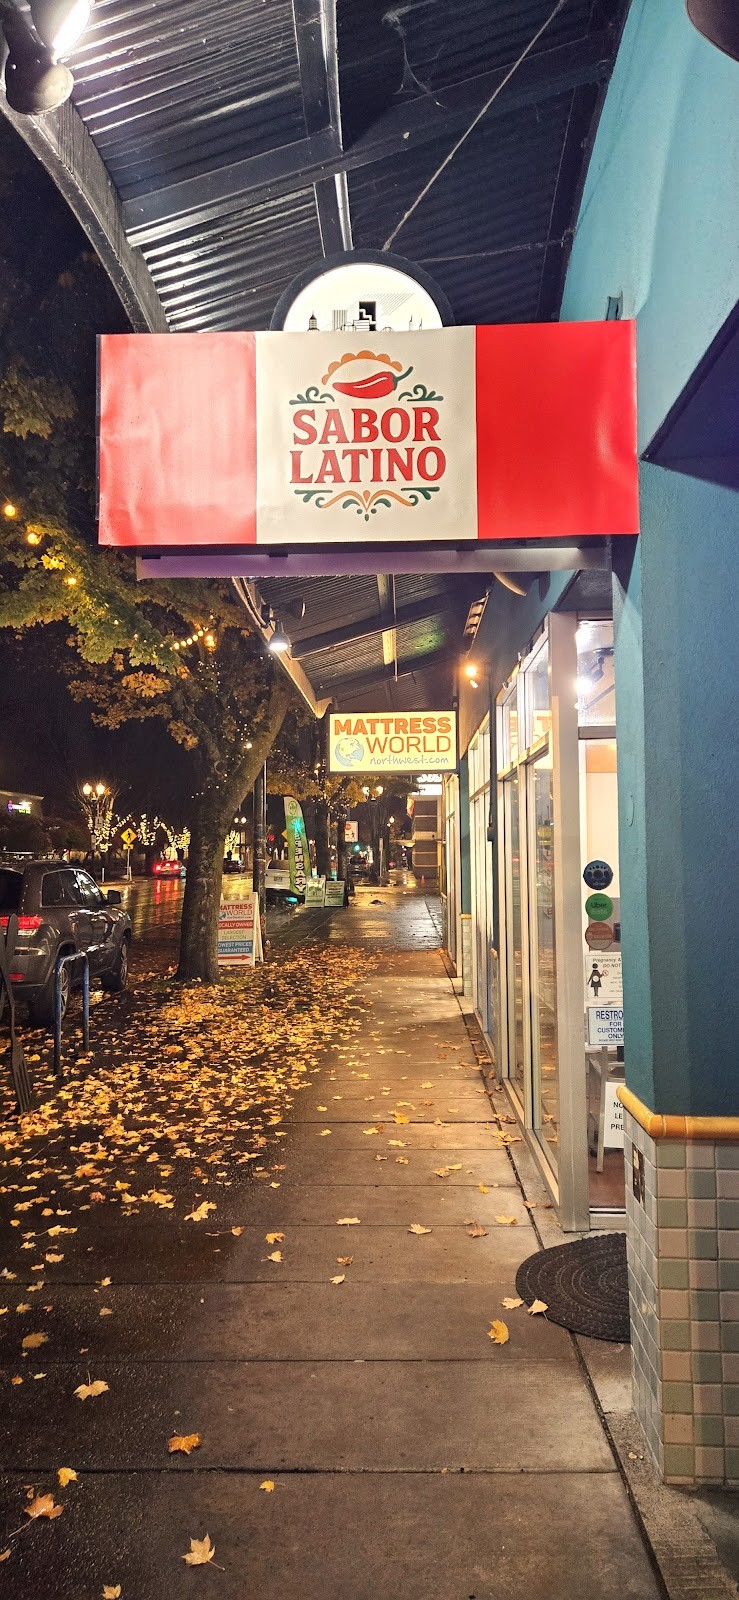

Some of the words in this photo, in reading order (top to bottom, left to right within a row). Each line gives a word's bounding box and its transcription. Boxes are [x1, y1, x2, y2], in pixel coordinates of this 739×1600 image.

[293, 407, 441, 445] SABOR
[289, 446, 446, 483] LATINO
[334, 717, 451, 735] MATTRESS
[365, 735, 451, 753] WORLD
[369, 754, 449, 765] northwest.com
